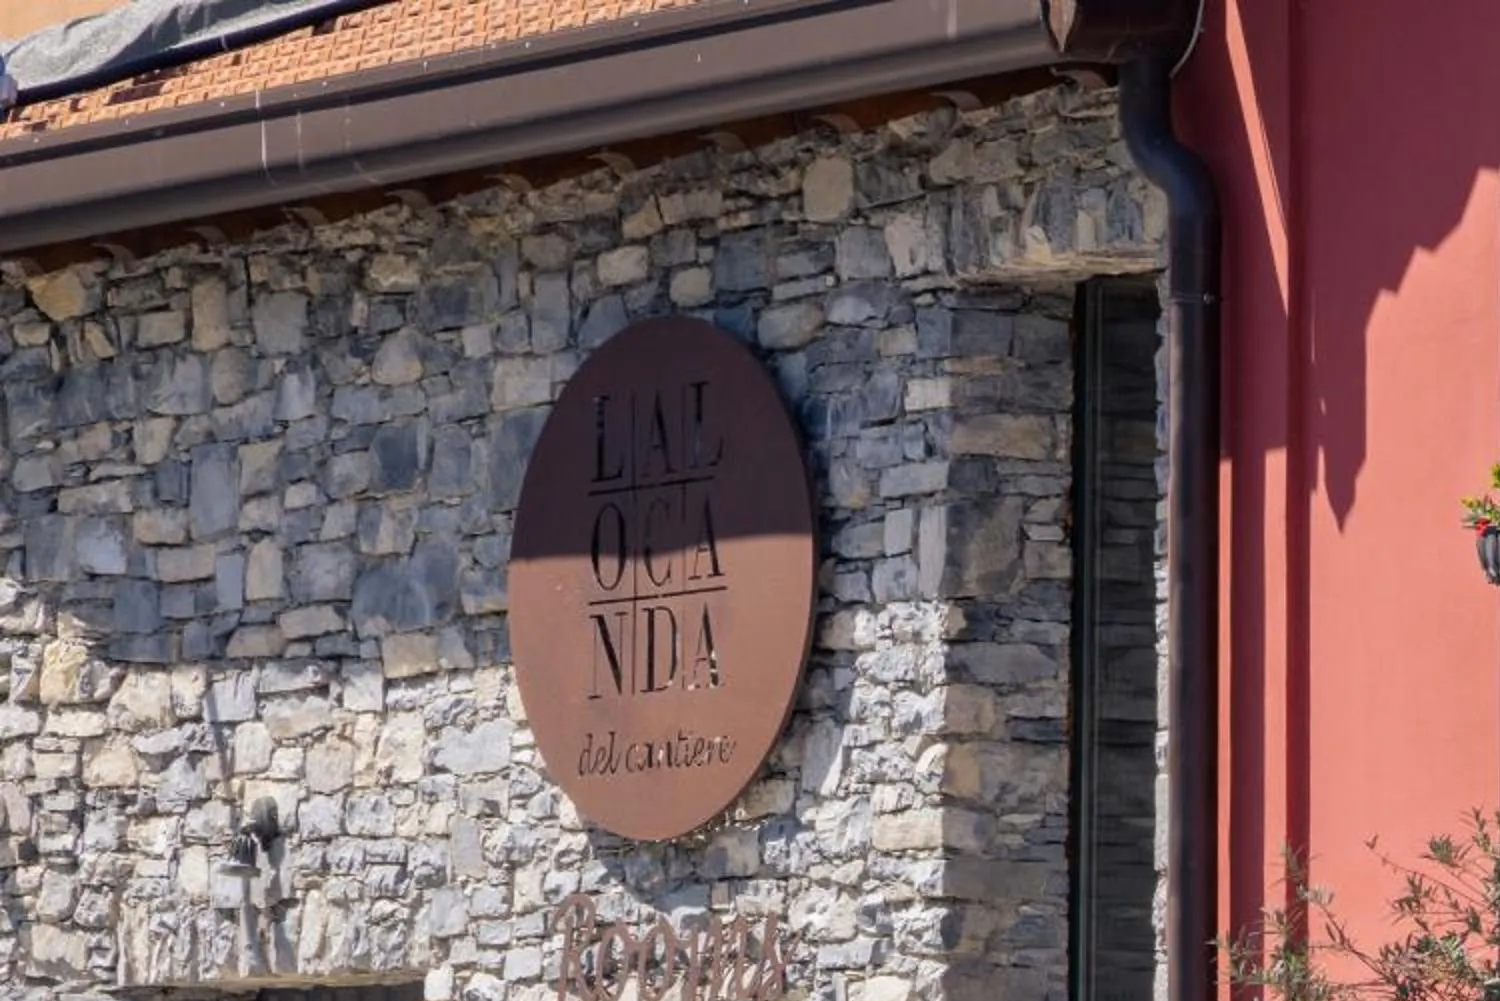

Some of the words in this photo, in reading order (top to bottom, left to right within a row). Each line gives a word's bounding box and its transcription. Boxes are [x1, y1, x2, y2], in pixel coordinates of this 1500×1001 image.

[589, 380, 724, 483] LAL
[590, 492, 725, 592] OCA
[587, 602, 726, 701] NDA
[578, 730, 620, 776] del
